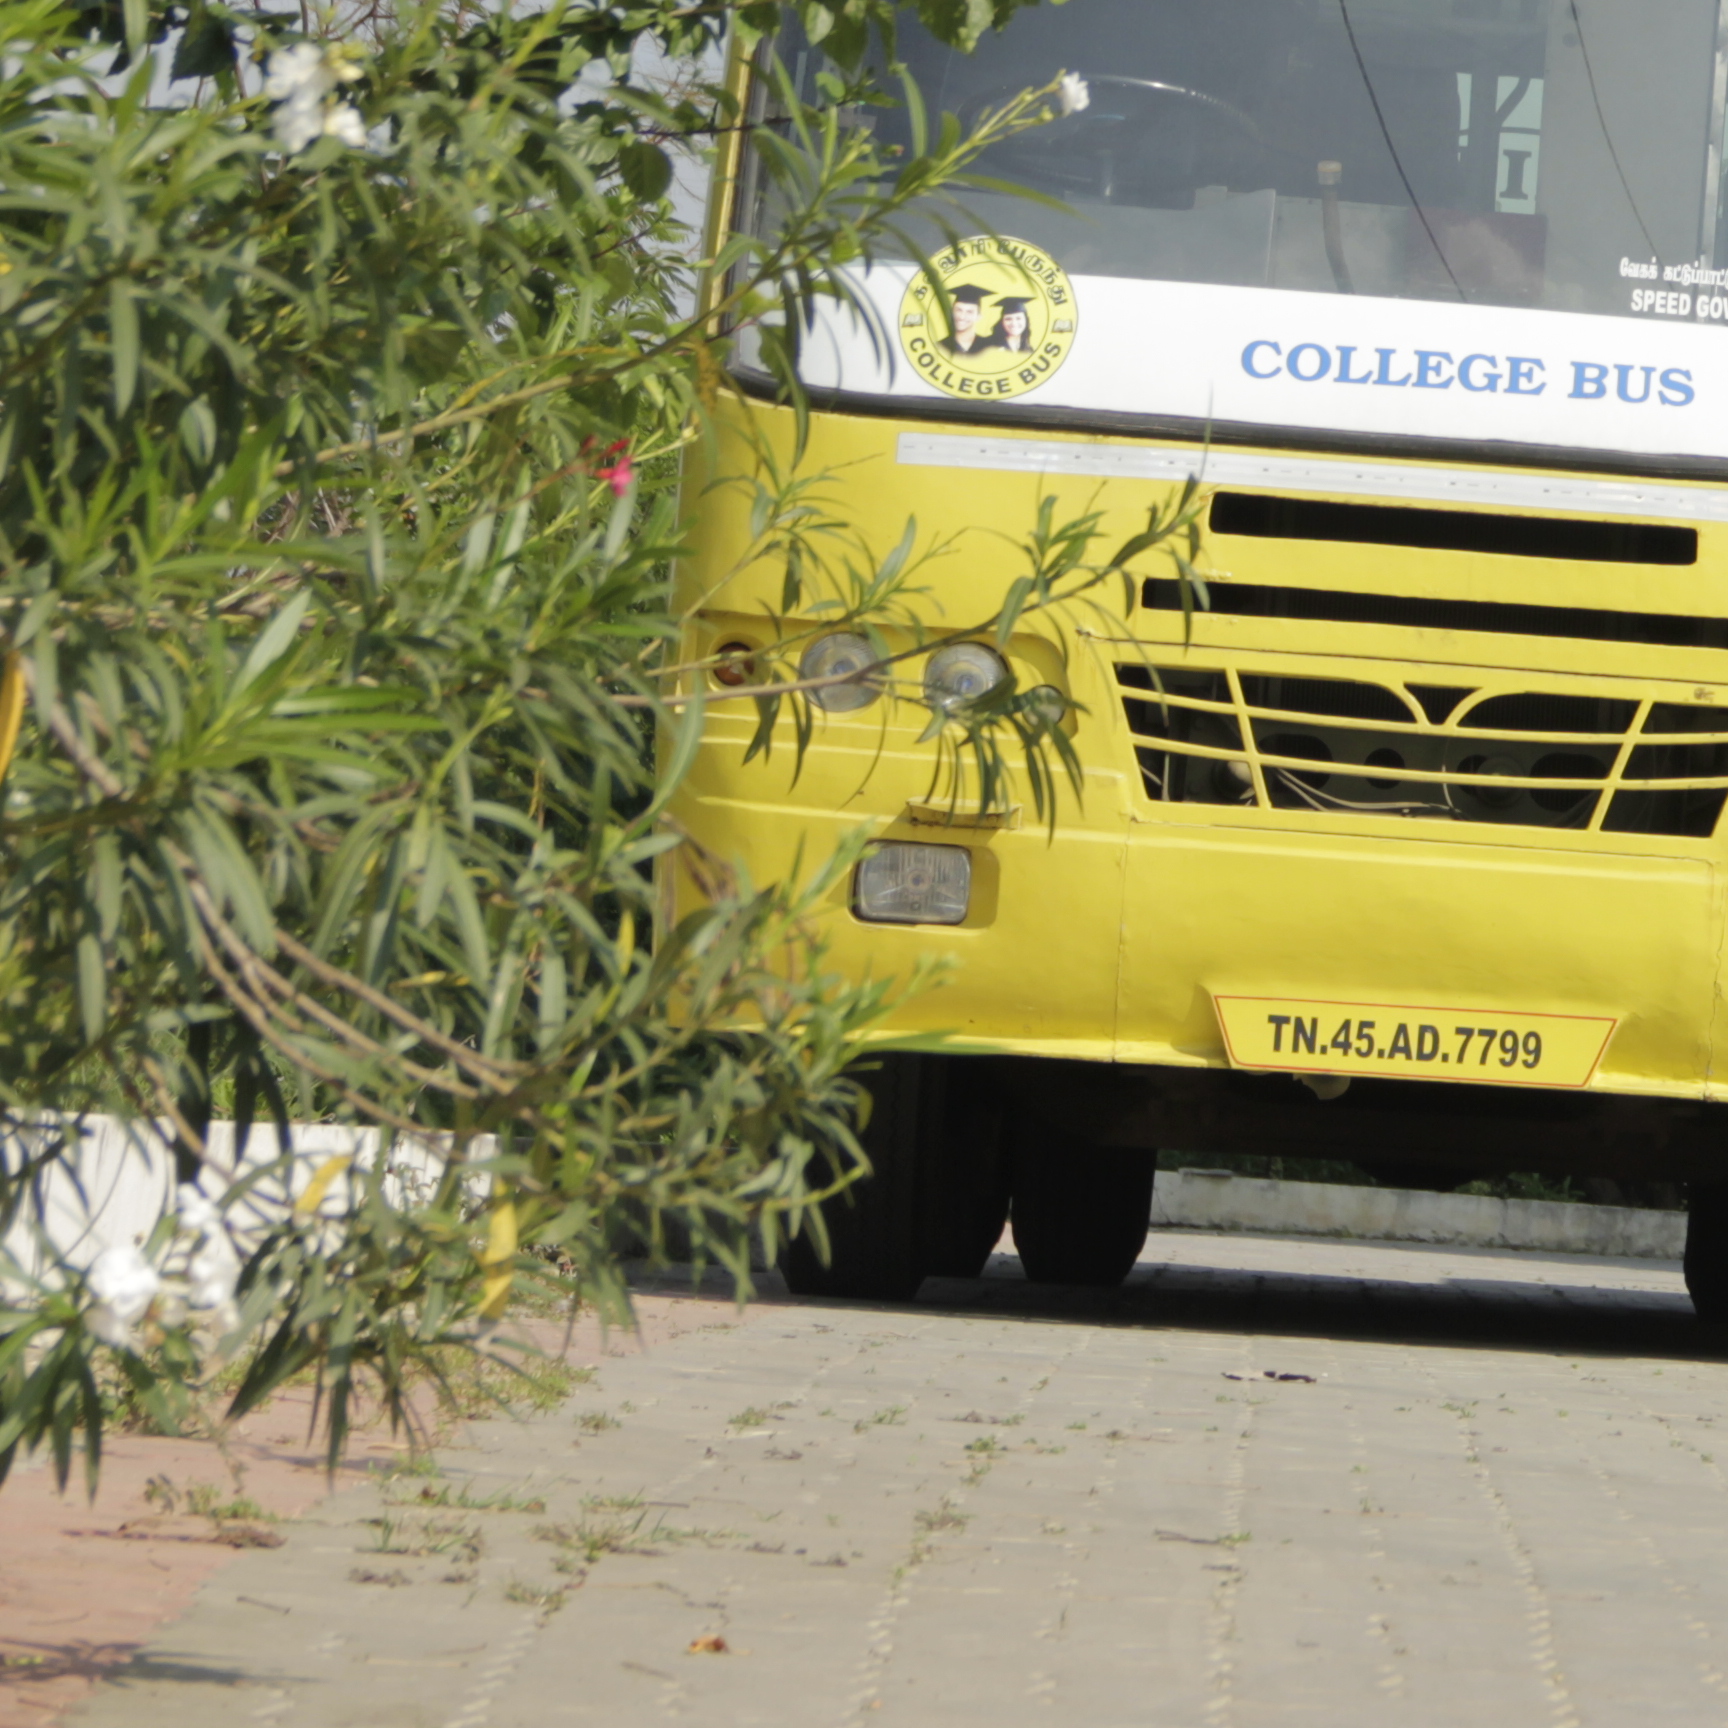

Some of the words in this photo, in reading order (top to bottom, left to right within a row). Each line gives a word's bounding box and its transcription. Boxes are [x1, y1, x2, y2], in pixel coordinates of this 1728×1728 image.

[1631, 288, 1691, 316] SPEED
[909, 337, 1012, 395] COLLEGE
[1018, 341, 1061, 386] BUS
[1240, 339, 1547, 396] COLLEGE
[1567, 360, 1696, 407] BUS
[1267, 1014, 1543, 1069] TN.45.AD.7799
